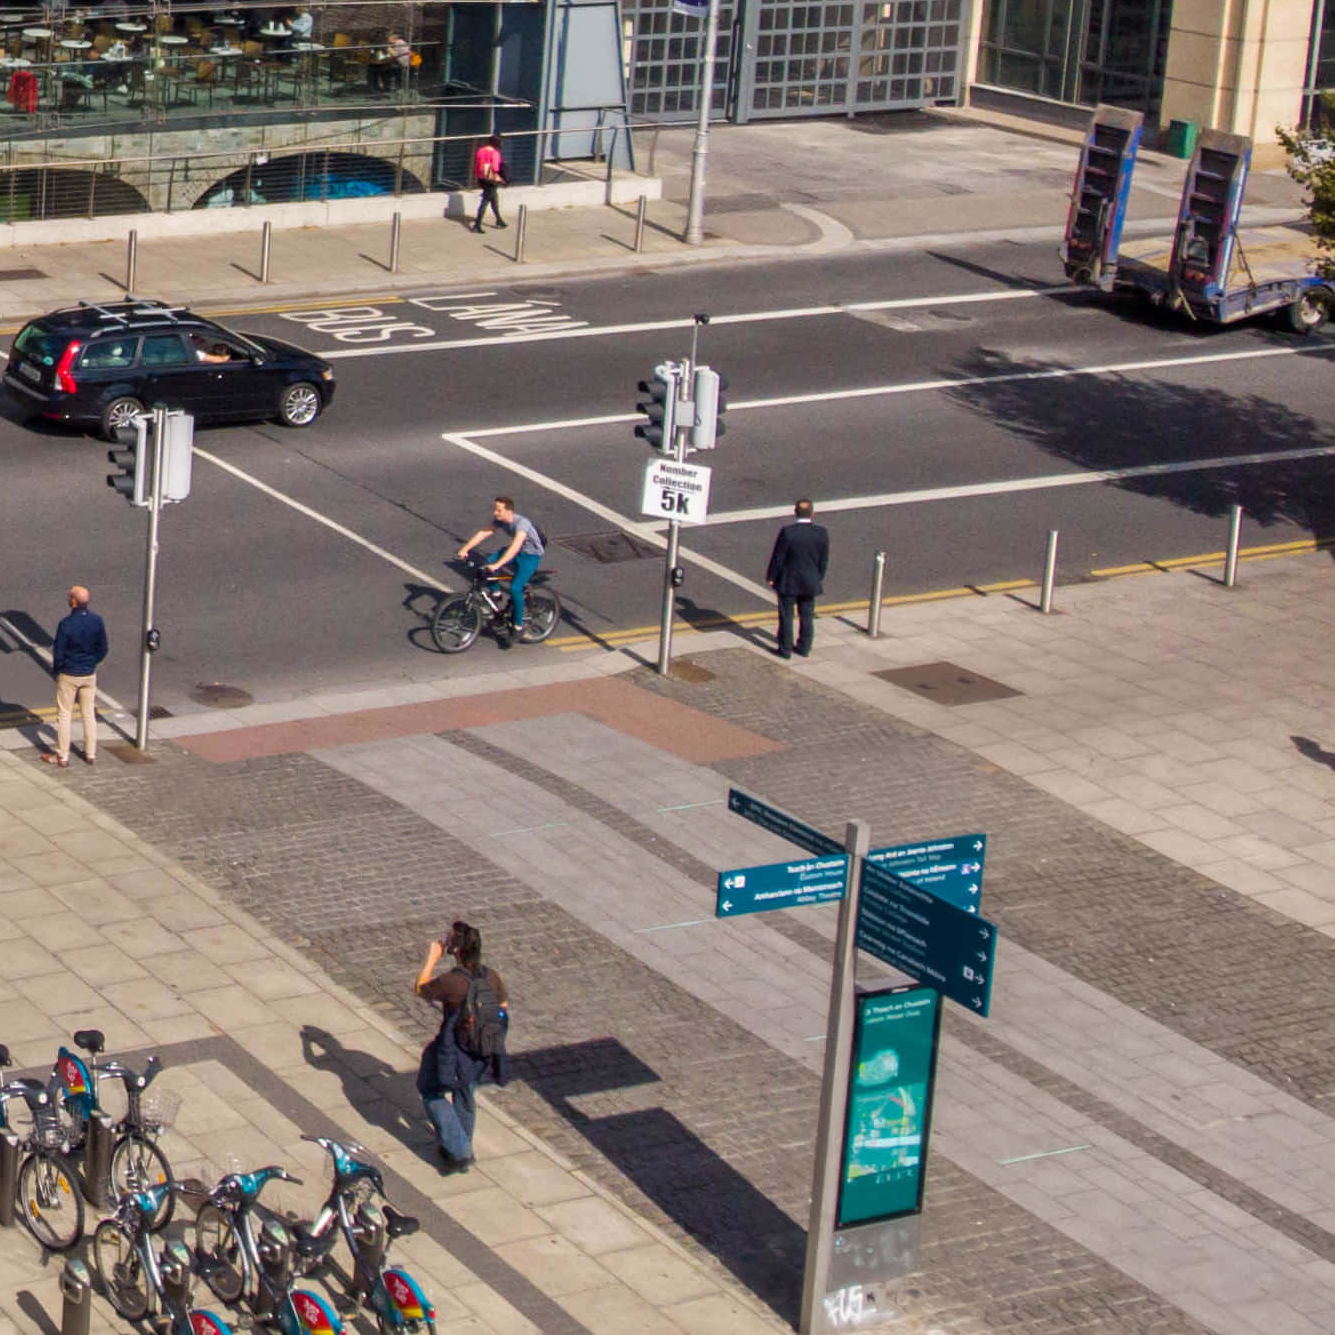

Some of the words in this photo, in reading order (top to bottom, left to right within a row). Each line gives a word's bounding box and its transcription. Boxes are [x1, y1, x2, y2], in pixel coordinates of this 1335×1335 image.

[279, 306, 436, 343] BUS
[659, 463, 699, 479] Number
[652, 474, 703, 492] Collection
[660, 489, 691, 515] 5k
